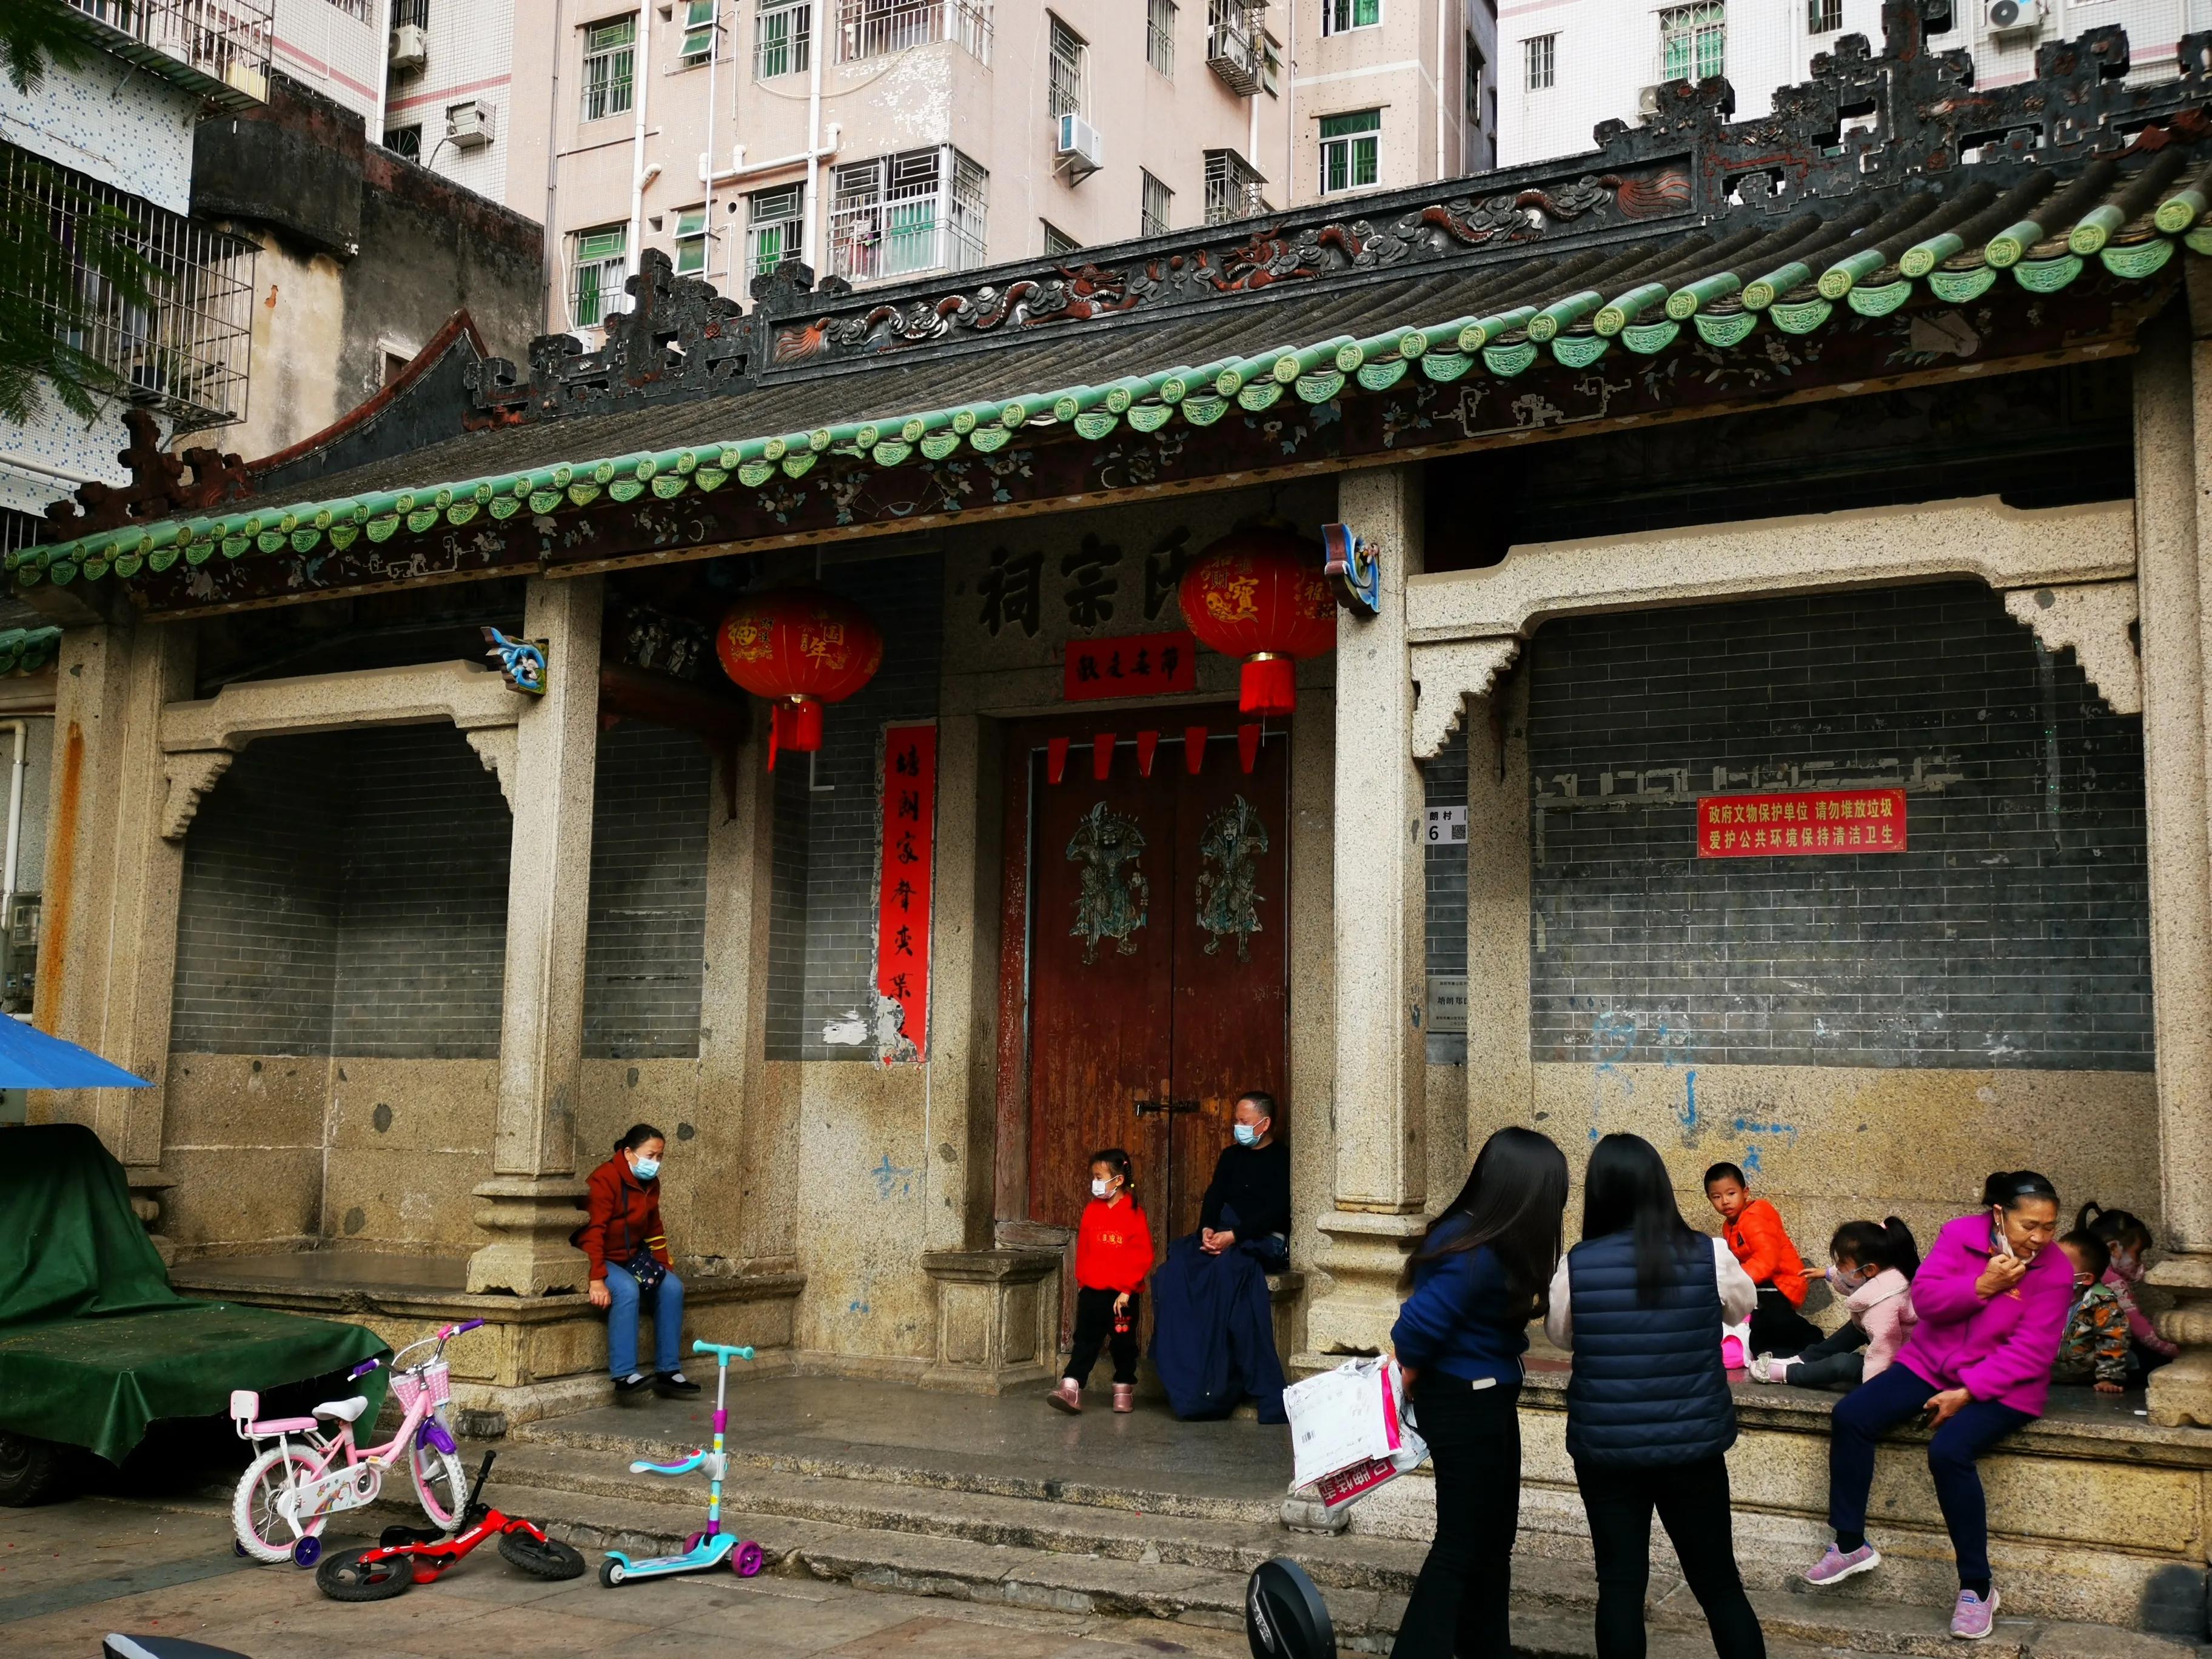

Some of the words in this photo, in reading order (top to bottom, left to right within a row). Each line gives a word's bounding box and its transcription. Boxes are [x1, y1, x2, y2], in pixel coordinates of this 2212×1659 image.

[1709, 802, 1808, 823] 政府文物保护单位
[1815, 798, 1892, 820] 请勿堆放垃圾
[1429, 825, 1439, 840] 6
[1709, 825, 1893, 850] 爱护公共环境保持清洁卫生
